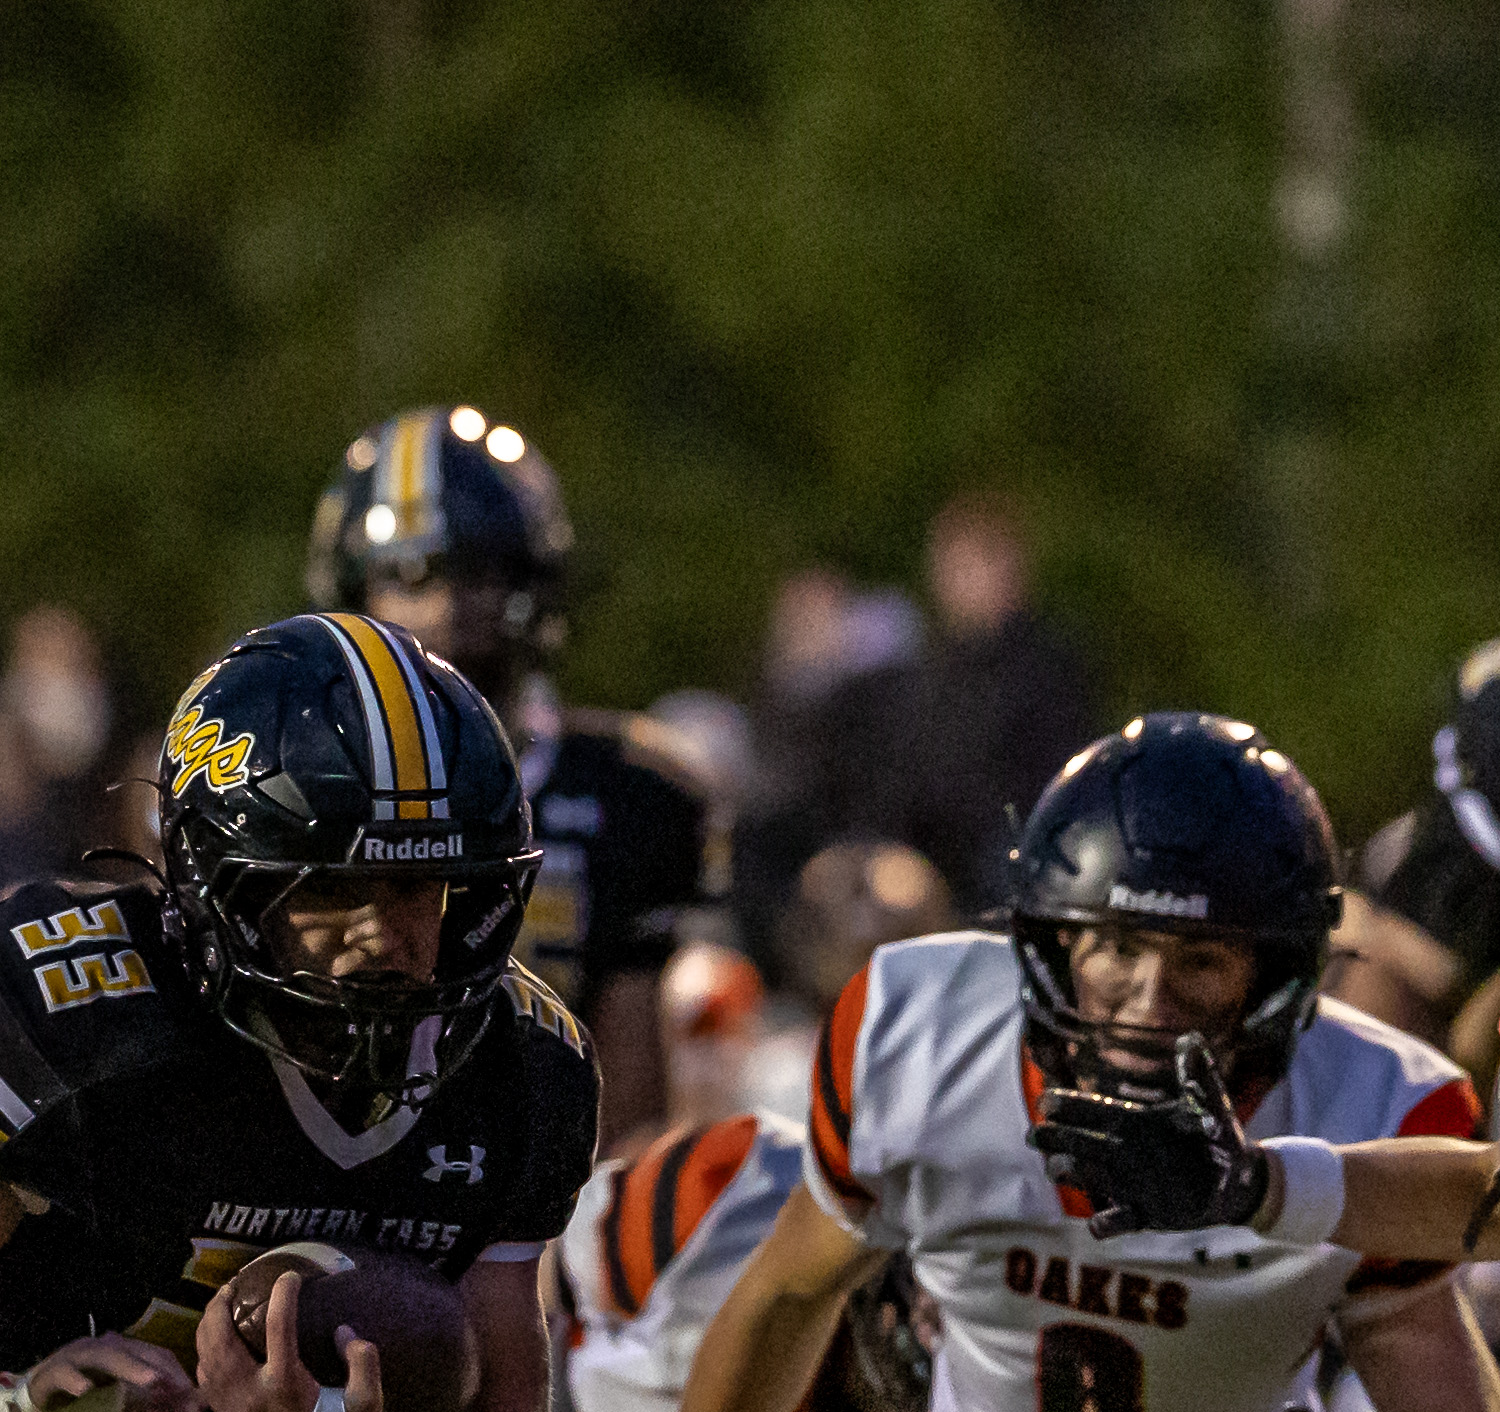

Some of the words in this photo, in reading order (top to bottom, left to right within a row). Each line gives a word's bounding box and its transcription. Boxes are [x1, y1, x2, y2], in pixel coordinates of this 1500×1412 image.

[364, 834, 463, 860] Riddell
[9, 899, 157, 1014] 33
[203, 1201, 368, 1239] NORTHERN
[378, 1218, 462, 1251] CASS
[1004, 1245, 1191, 1331] OAKES
